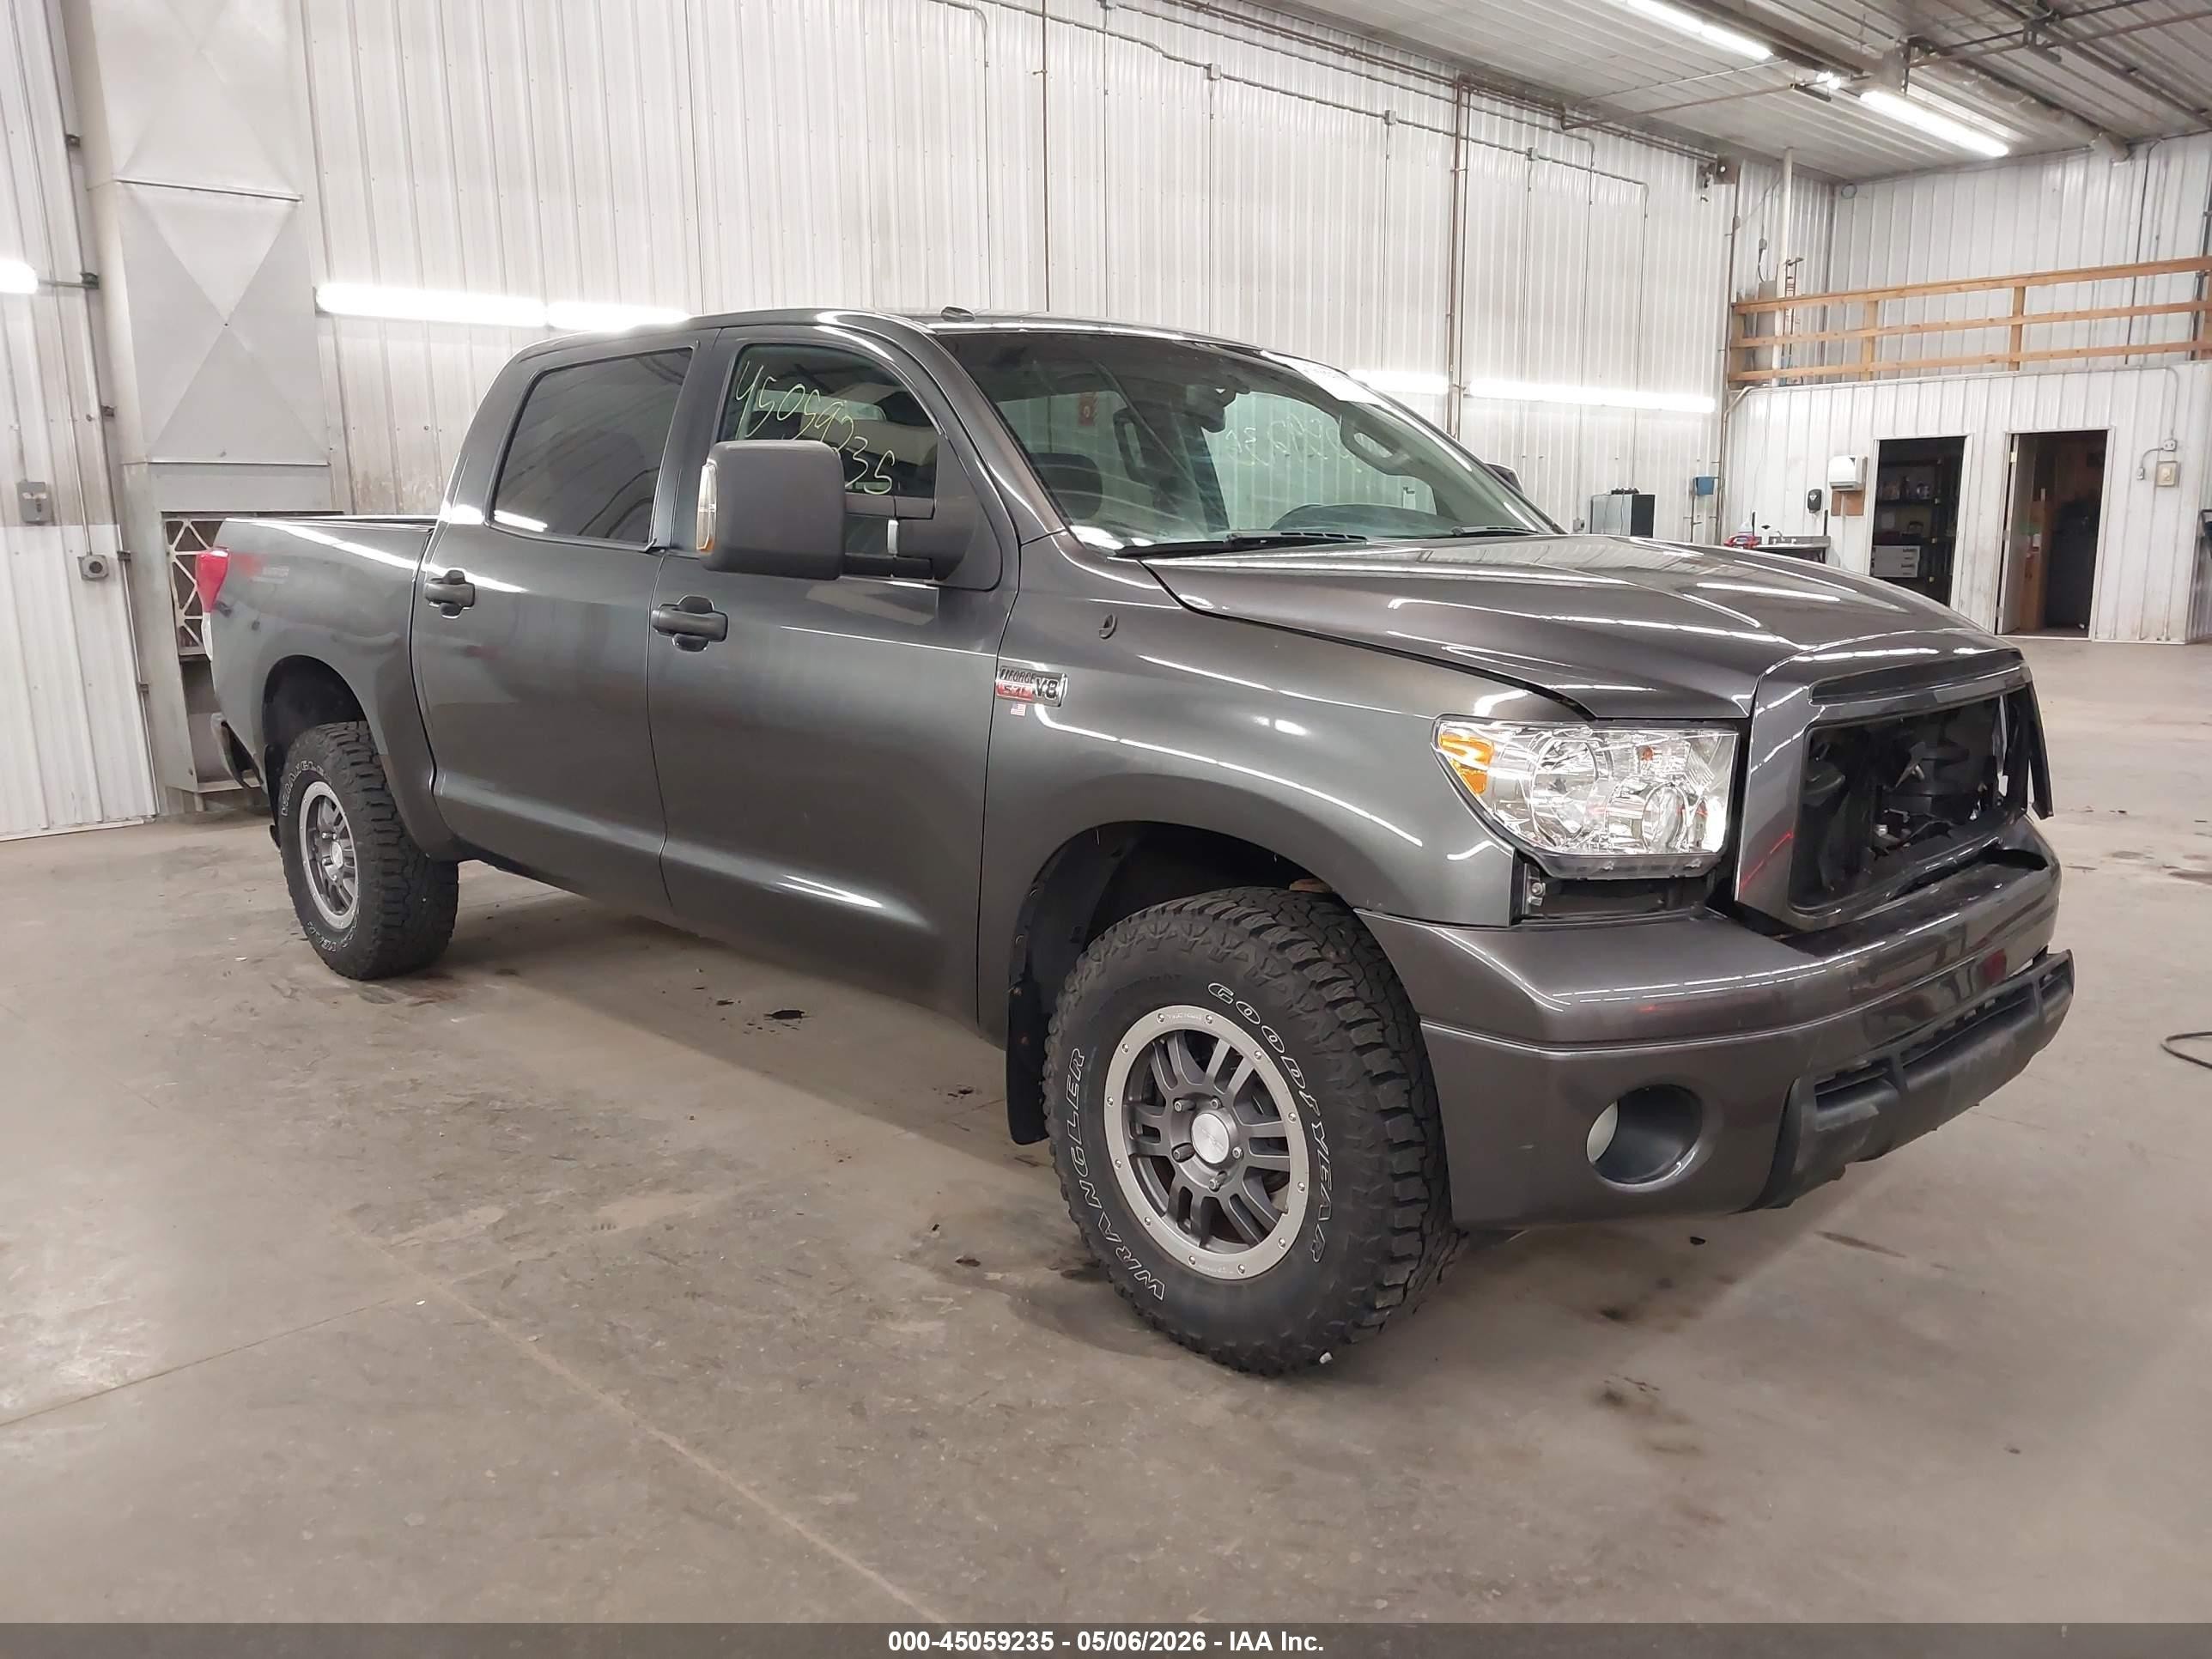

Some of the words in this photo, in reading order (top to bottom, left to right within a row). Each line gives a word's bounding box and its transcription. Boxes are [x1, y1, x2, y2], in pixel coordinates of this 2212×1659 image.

[1035, 676, 1060, 700] V8
[1066, 1048, 1166, 1302] WRANGLER
[1207, 981, 1333, 1263] GOODYEAR
